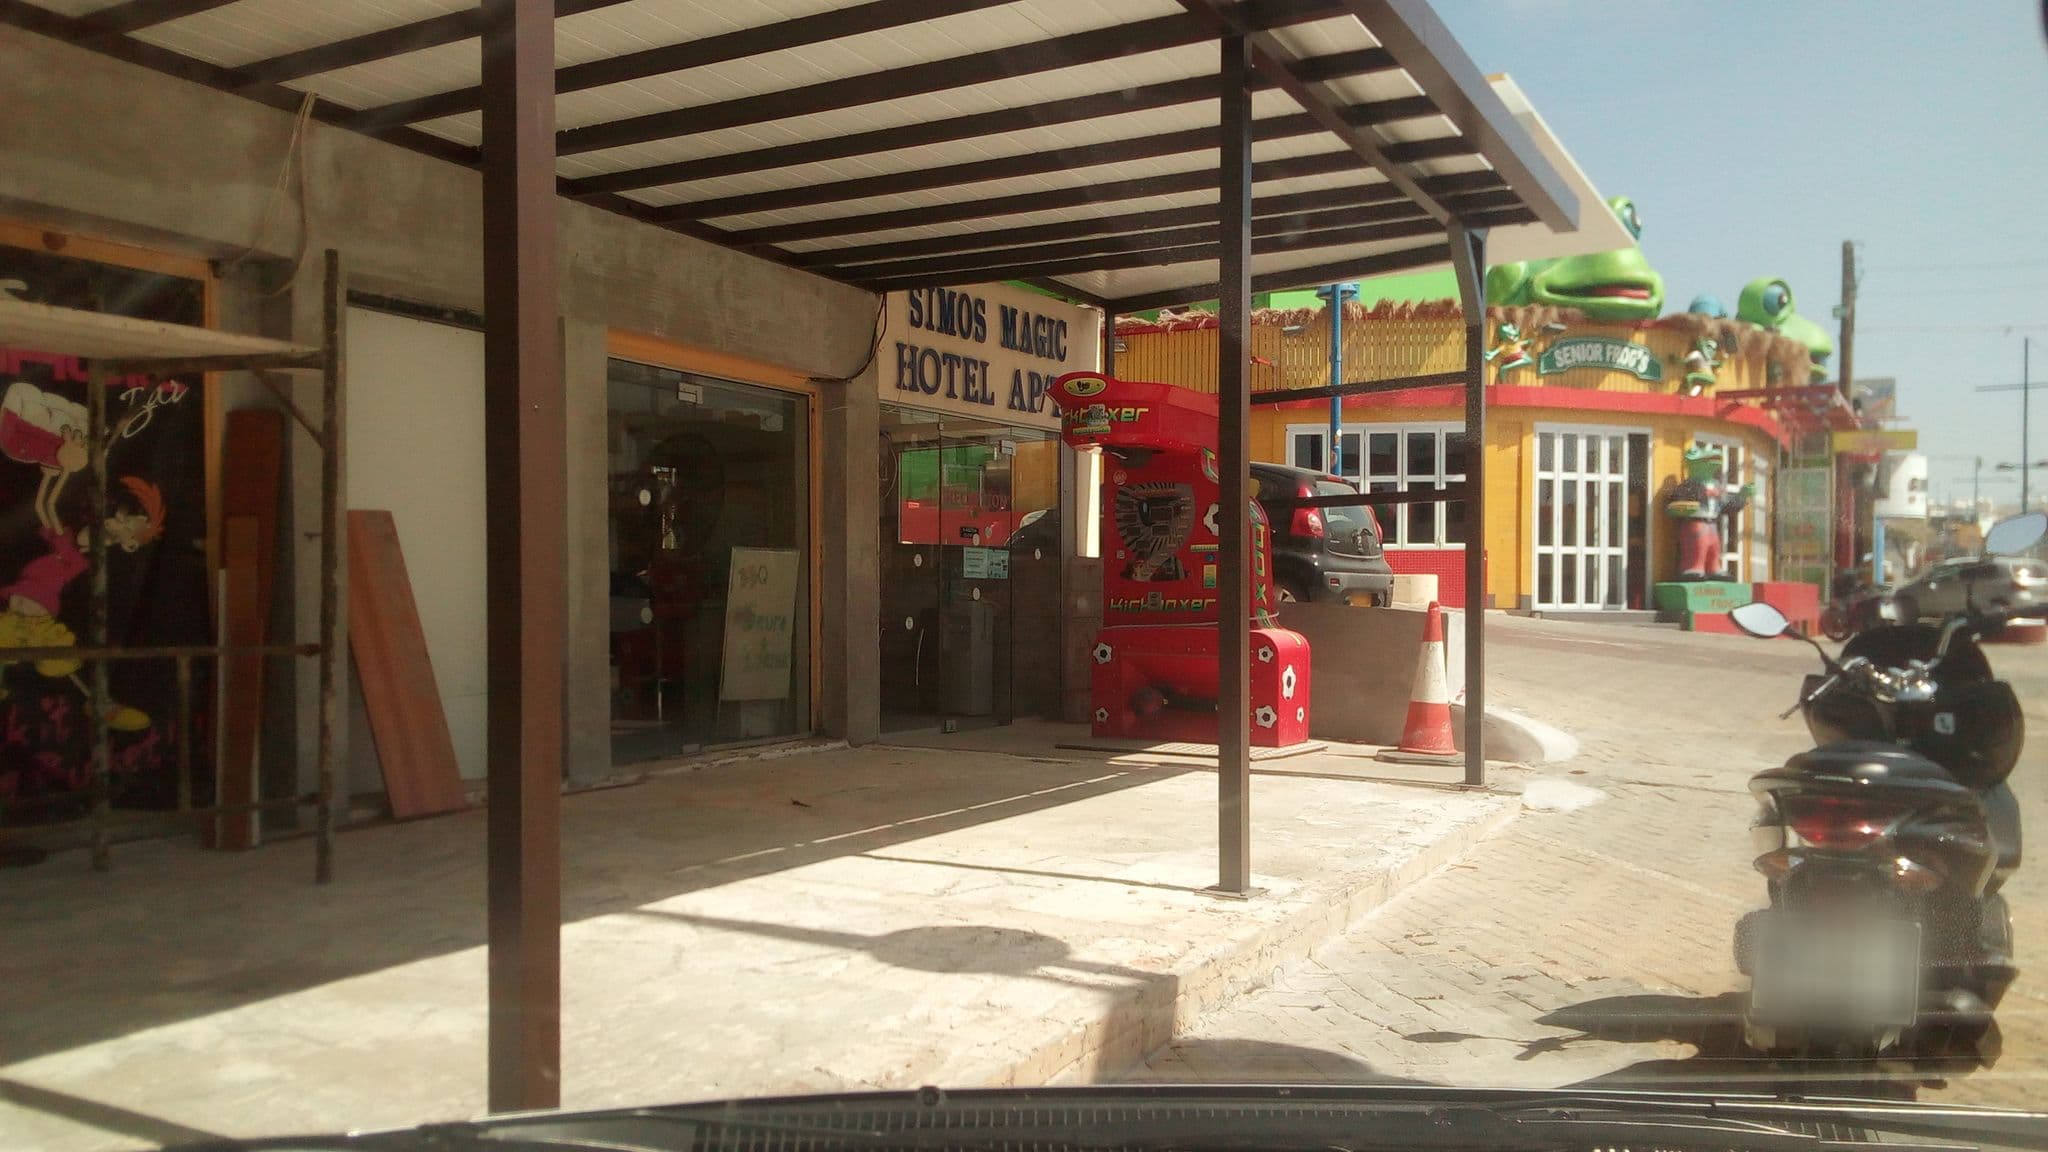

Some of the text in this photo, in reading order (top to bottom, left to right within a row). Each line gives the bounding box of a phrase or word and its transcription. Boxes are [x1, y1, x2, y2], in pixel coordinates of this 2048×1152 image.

[909, 286, 1067, 362] SIMOS MAGIC
[1554, 342, 1603, 367] SENIOR
[896, 342, 994, 405] HOTEL
